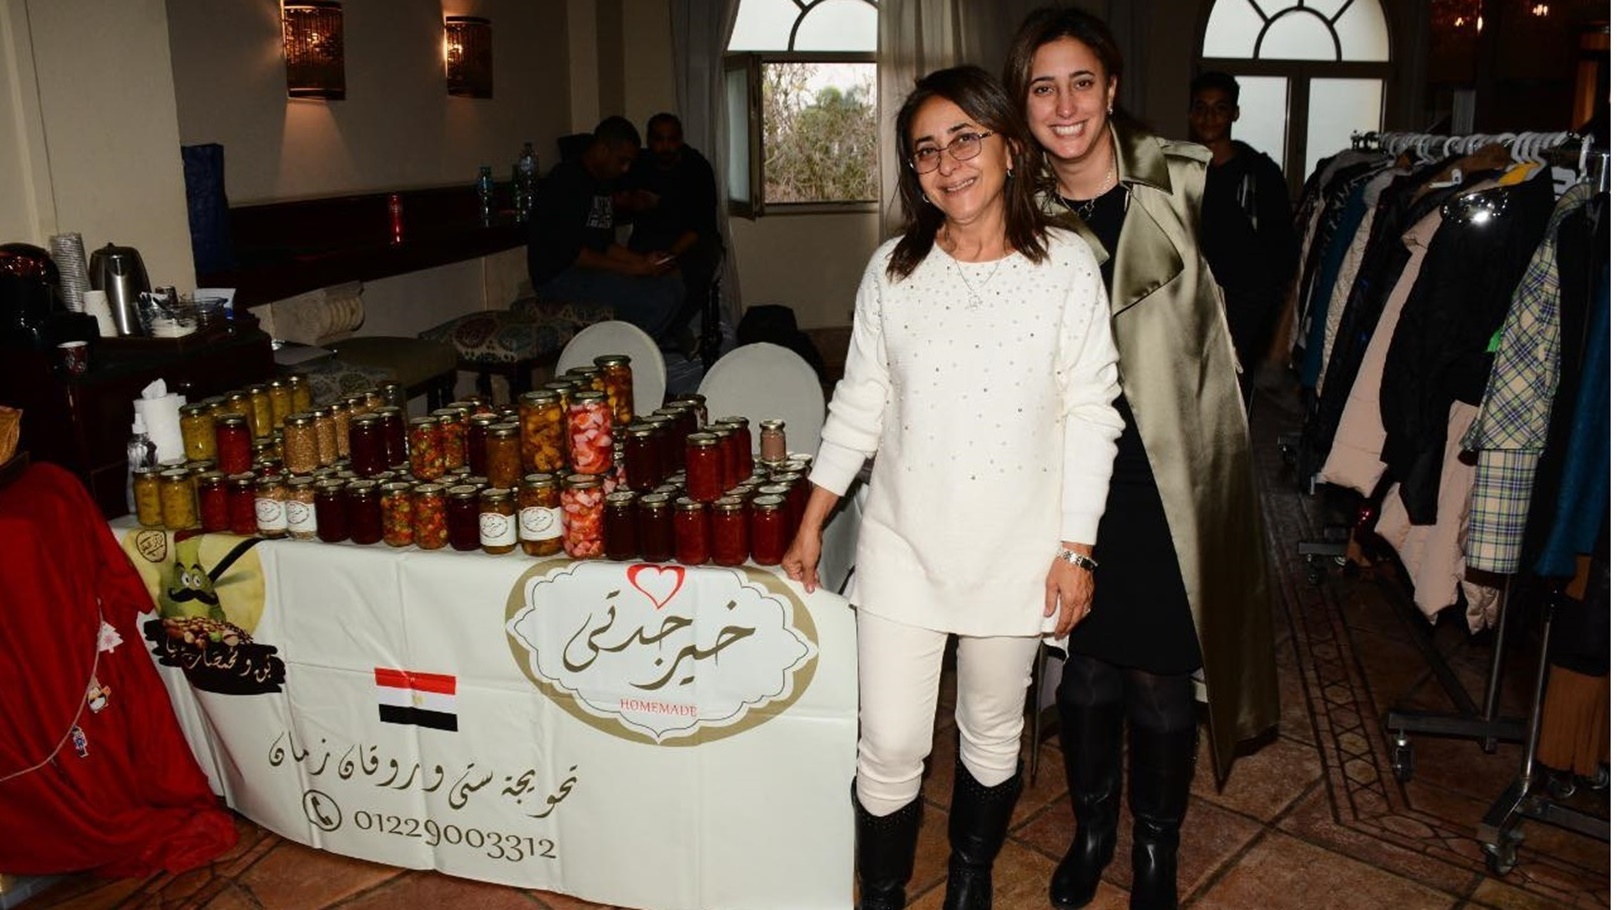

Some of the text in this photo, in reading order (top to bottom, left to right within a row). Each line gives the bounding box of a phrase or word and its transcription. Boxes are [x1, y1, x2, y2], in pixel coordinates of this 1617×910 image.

[629, 600, 757, 690] خير
[620, 698, 698, 718] HOMEMADE
[353, 810, 558, 863] 01229003312
